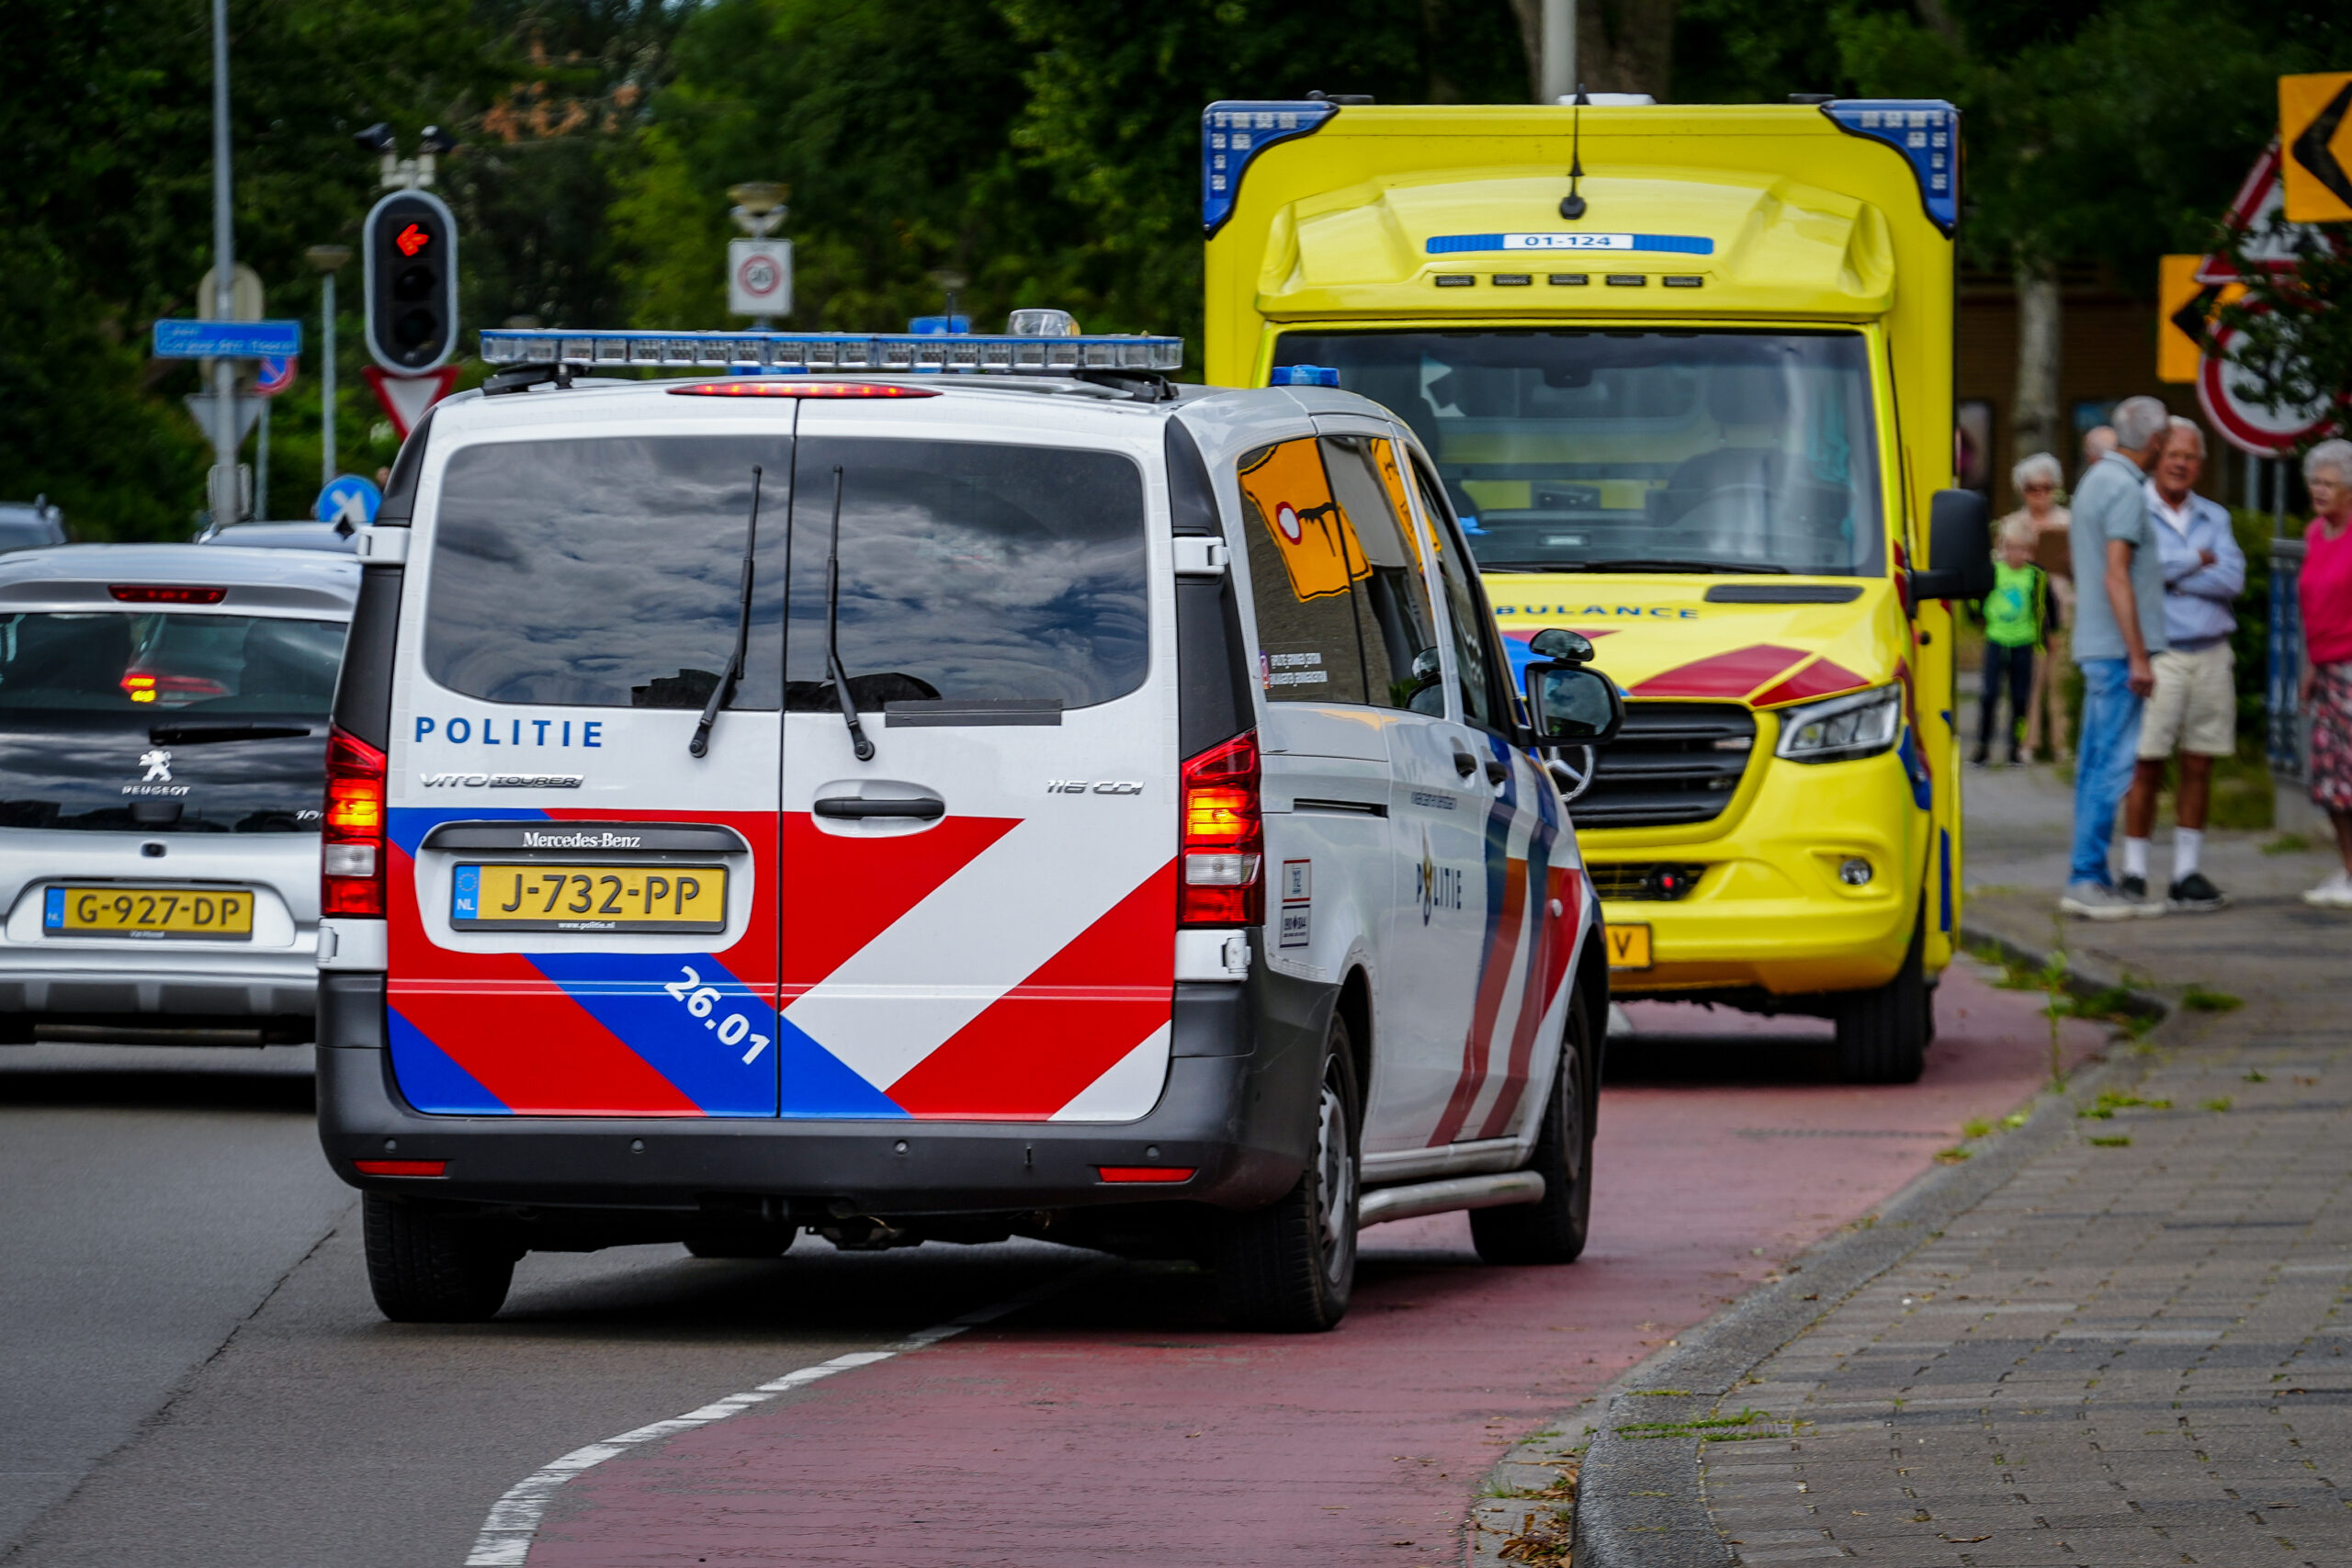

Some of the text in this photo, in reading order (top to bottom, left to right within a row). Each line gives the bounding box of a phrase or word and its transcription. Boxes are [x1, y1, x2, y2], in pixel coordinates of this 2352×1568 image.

[1524, 236, 1611, 246] 01-124
[1495, 604, 1701, 618] BULANCE
[414, 716, 602, 747] POLITIE
[419, 773, 582, 788] VITO TOURER
[121, 785, 191, 795] PEUGEOT
[1092, 781, 1145, 795] CDI
[295, 810, 323, 820] 10
[522, 831, 641, 848] Mercedes-Benz
[502, 874, 699, 914] J-732-PP
[77, 894, 241, 926] G-927-DP
[457, 897, 475, 910] NL
[558, 921, 616, 930] www.politie.nl
[1612, 931, 1633, 959] V
[663, 965, 771, 1066] 26.01
